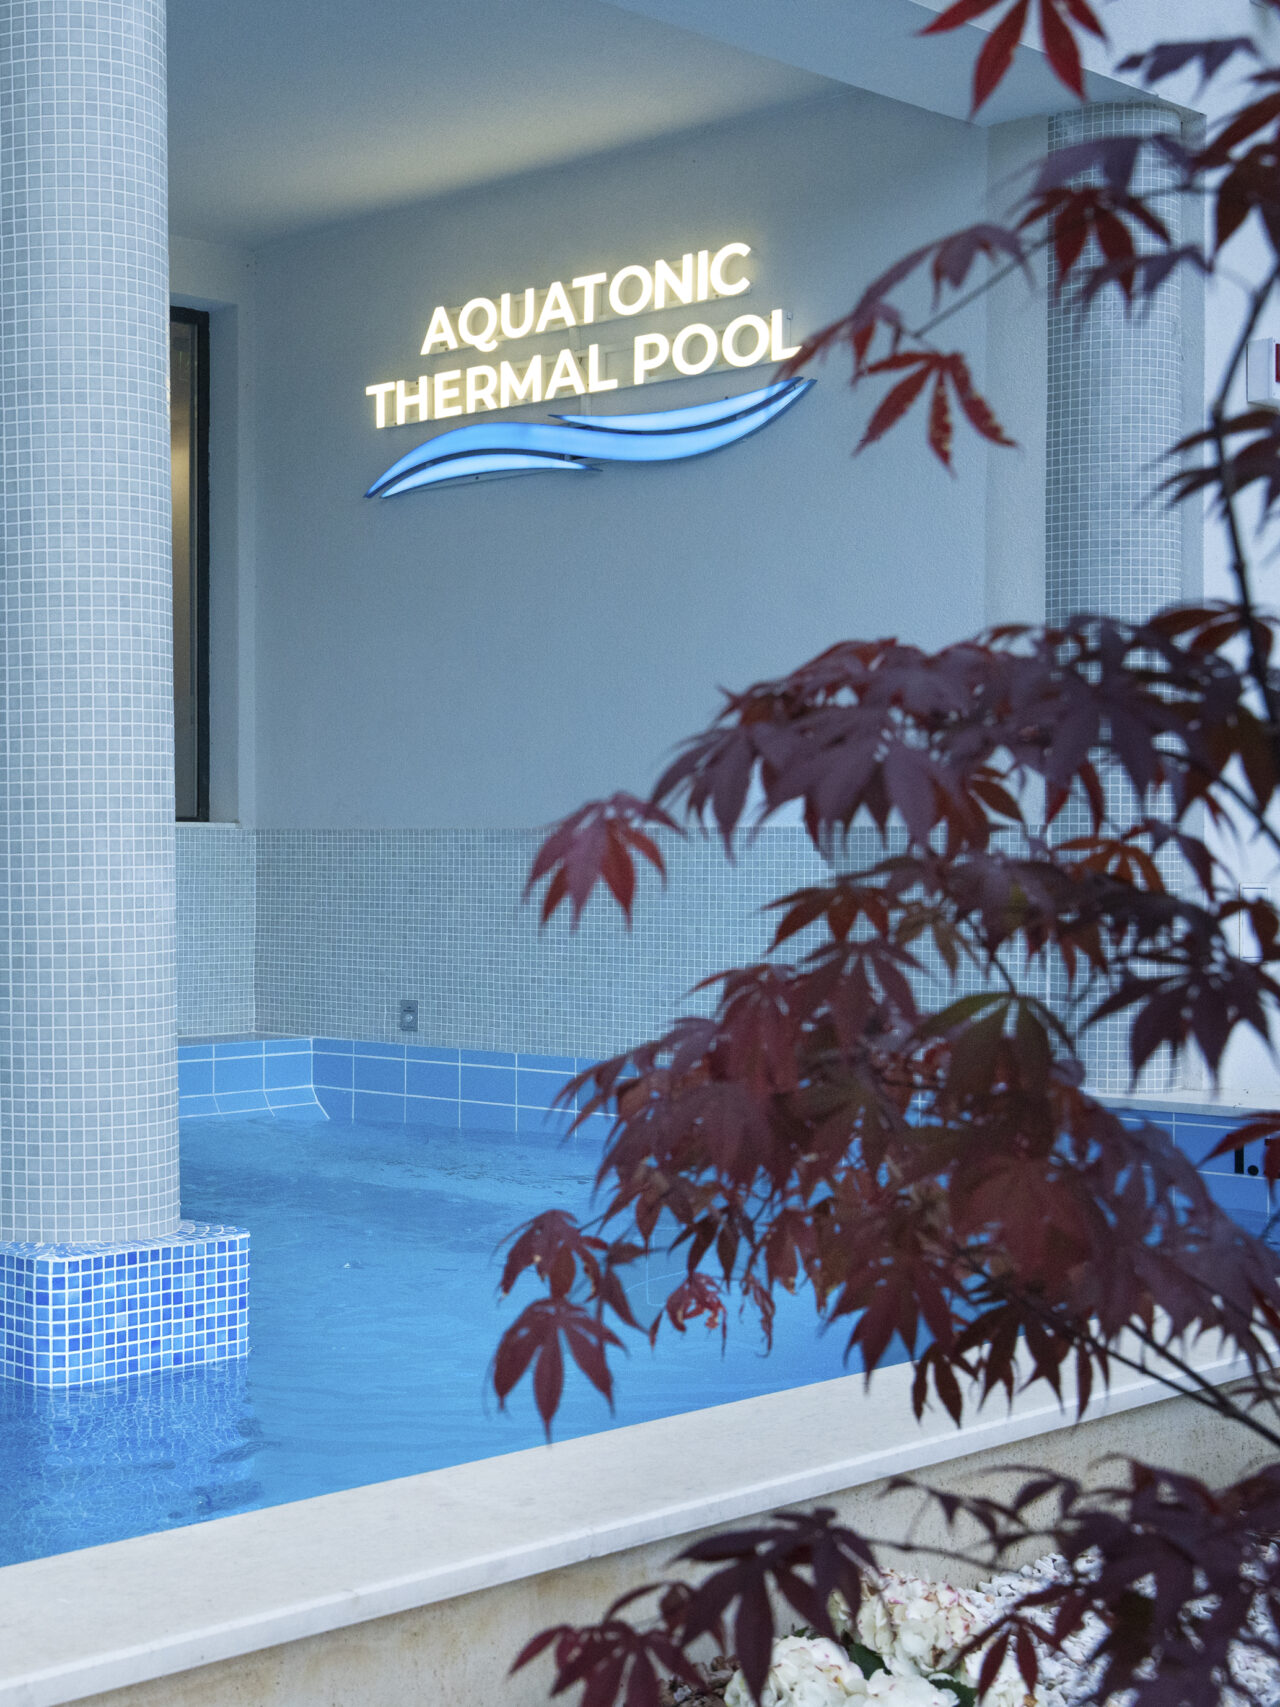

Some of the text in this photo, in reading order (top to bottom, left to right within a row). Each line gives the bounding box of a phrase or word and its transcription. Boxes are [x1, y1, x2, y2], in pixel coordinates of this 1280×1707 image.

[420, 242, 752, 355] AQUATONIC
[365, 308, 802, 429] THERMAL POOL
